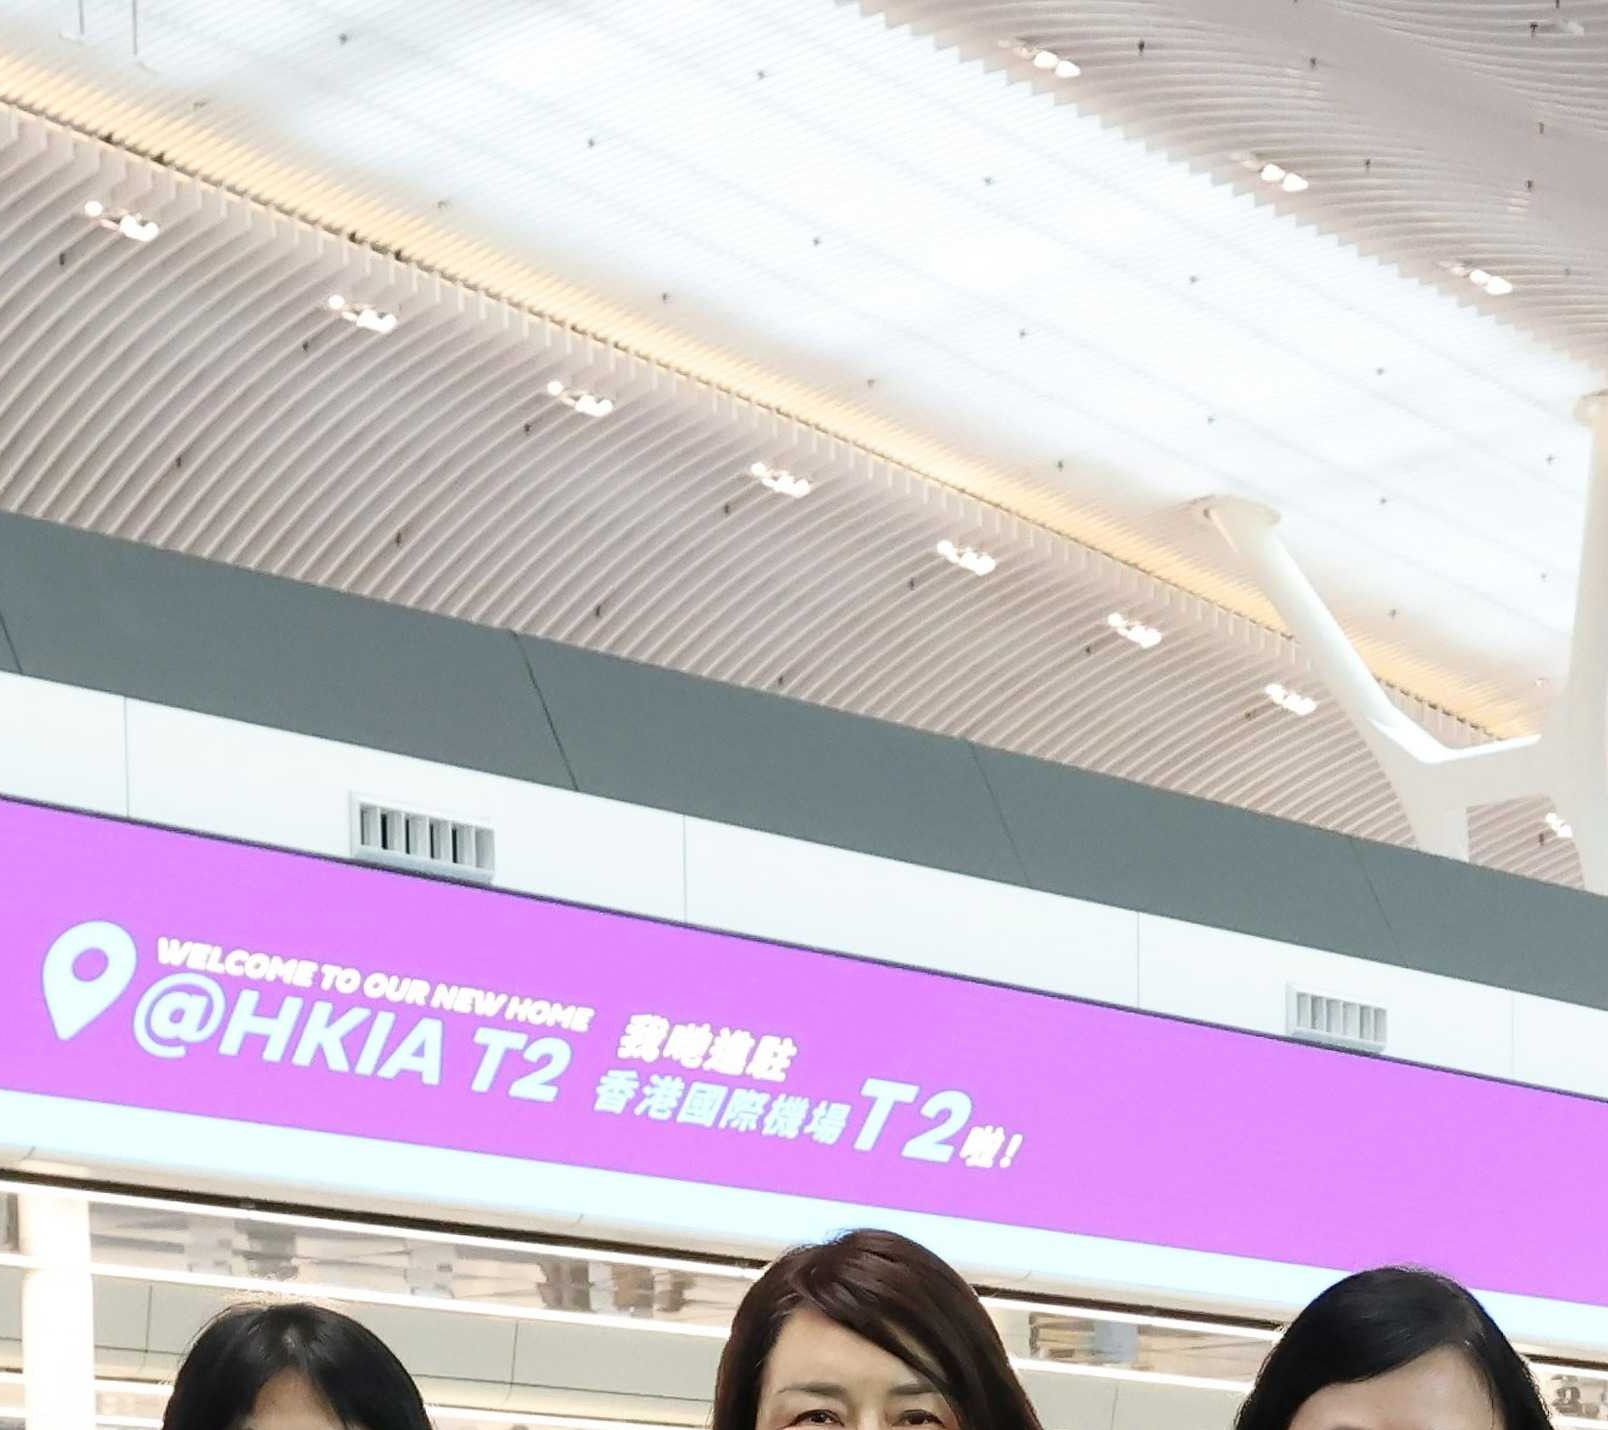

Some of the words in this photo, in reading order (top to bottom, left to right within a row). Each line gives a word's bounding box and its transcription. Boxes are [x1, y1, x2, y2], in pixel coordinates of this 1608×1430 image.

[134, 973, 442, 1084] @HKIA
[472, 1028, 571, 1101] T2
[158, 938, 318, 987] WELCOME
[322, 965, 360, 993] TO
[364, 973, 430, 1005] OUR
[431, 984, 508, 1016] NEW
[505, 997, 594, 1031] HOME
